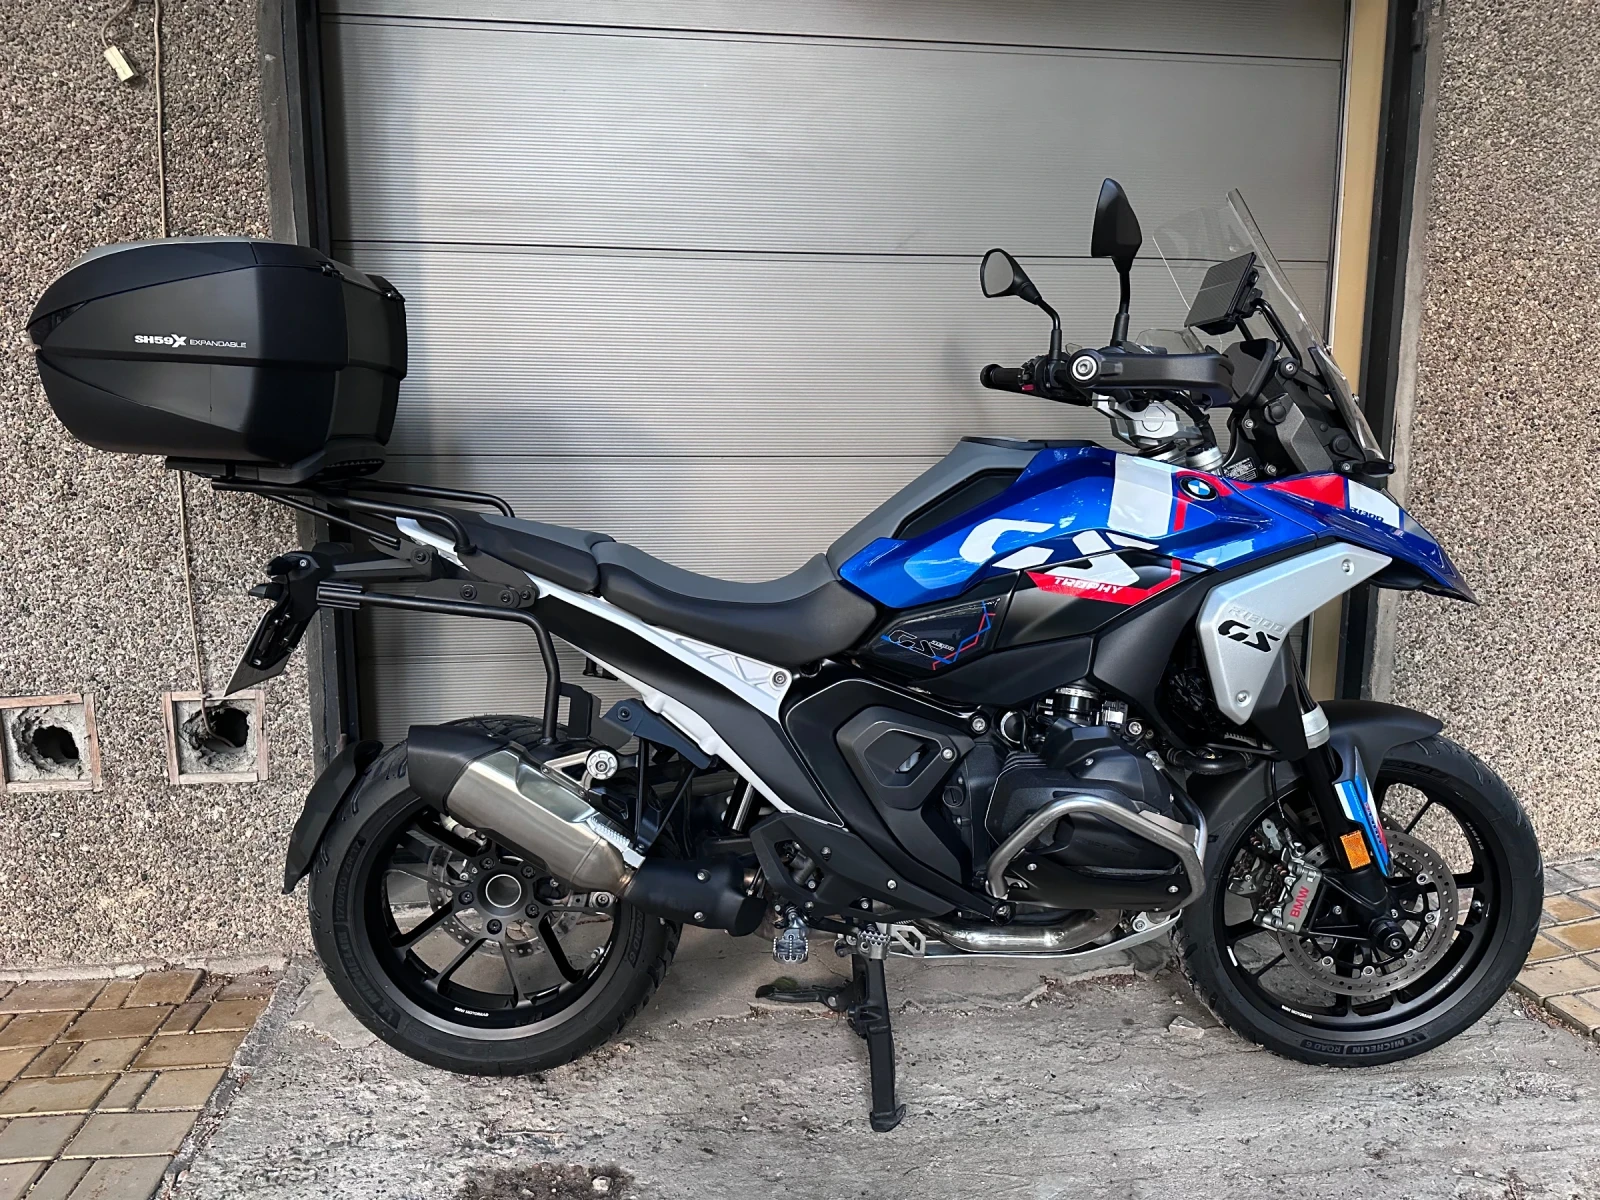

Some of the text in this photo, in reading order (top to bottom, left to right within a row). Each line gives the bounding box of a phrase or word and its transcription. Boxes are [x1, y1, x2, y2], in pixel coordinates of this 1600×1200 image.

[134, 334, 247, 348] SH59X EXPANDABLE
[1054, 576, 1124, 594] TROPHY
[1217, 619, 1281, 653] GS
[335, 877, 348, 920] 170/60
[1290, 886, 1310, 918] BMW
[633, 909, 644, 950] ROAD
[337, 931, 381, 1005] MICHELIN
[1315, 1044, 1341, 1053] ROAD
[1352, 1039, 1405, 1054] MICHELIN
